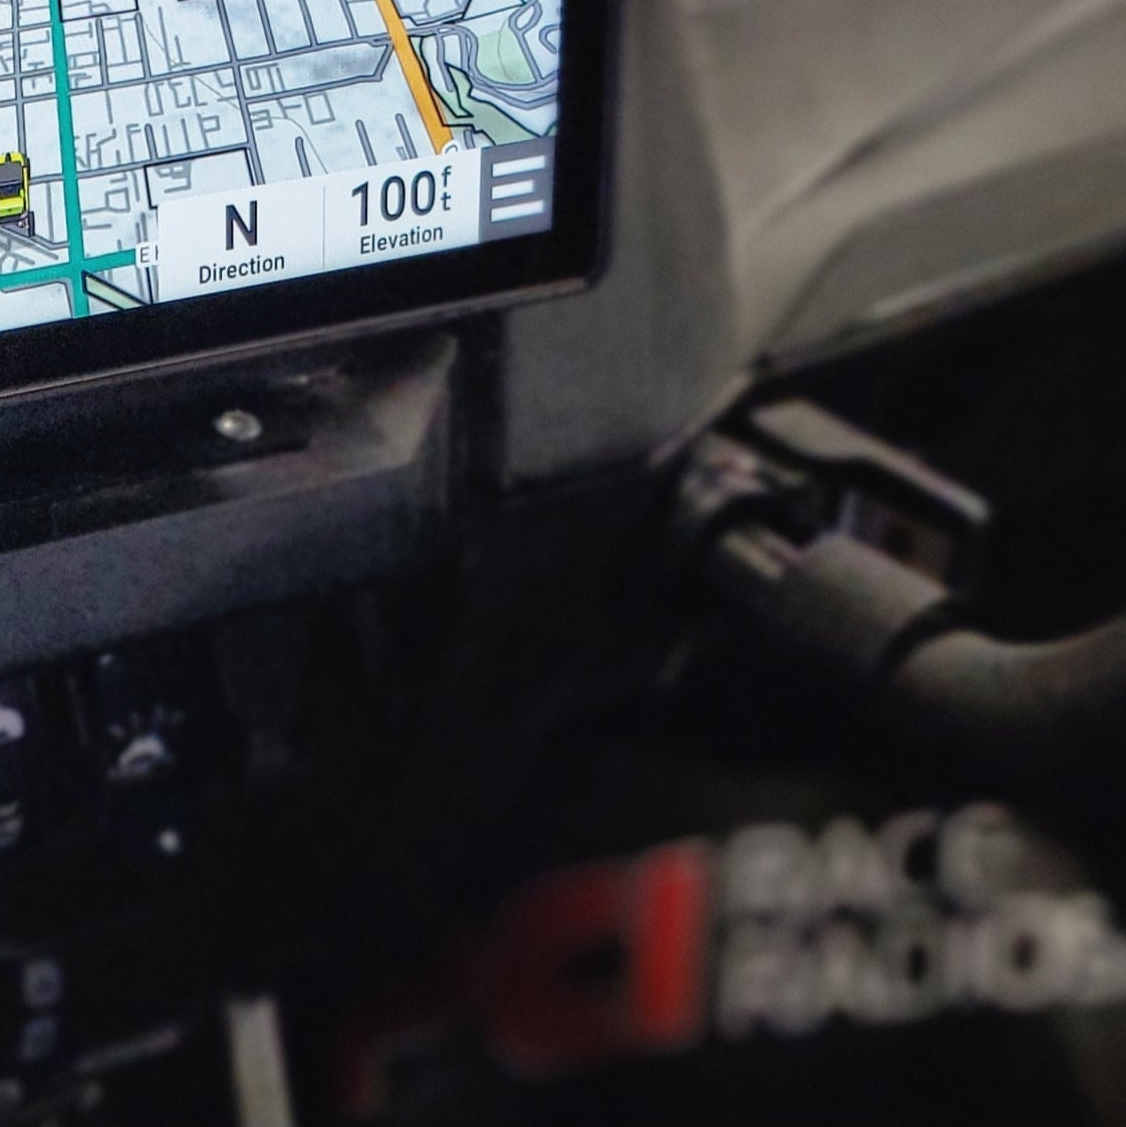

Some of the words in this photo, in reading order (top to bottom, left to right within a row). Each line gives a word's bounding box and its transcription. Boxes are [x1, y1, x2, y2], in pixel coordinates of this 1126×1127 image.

[351, 170, 436, 227] 100
[225, 200, 258, 251] N
[360, 225, 443, 254] Elevation
[199, 254, 285, 284] Direction
